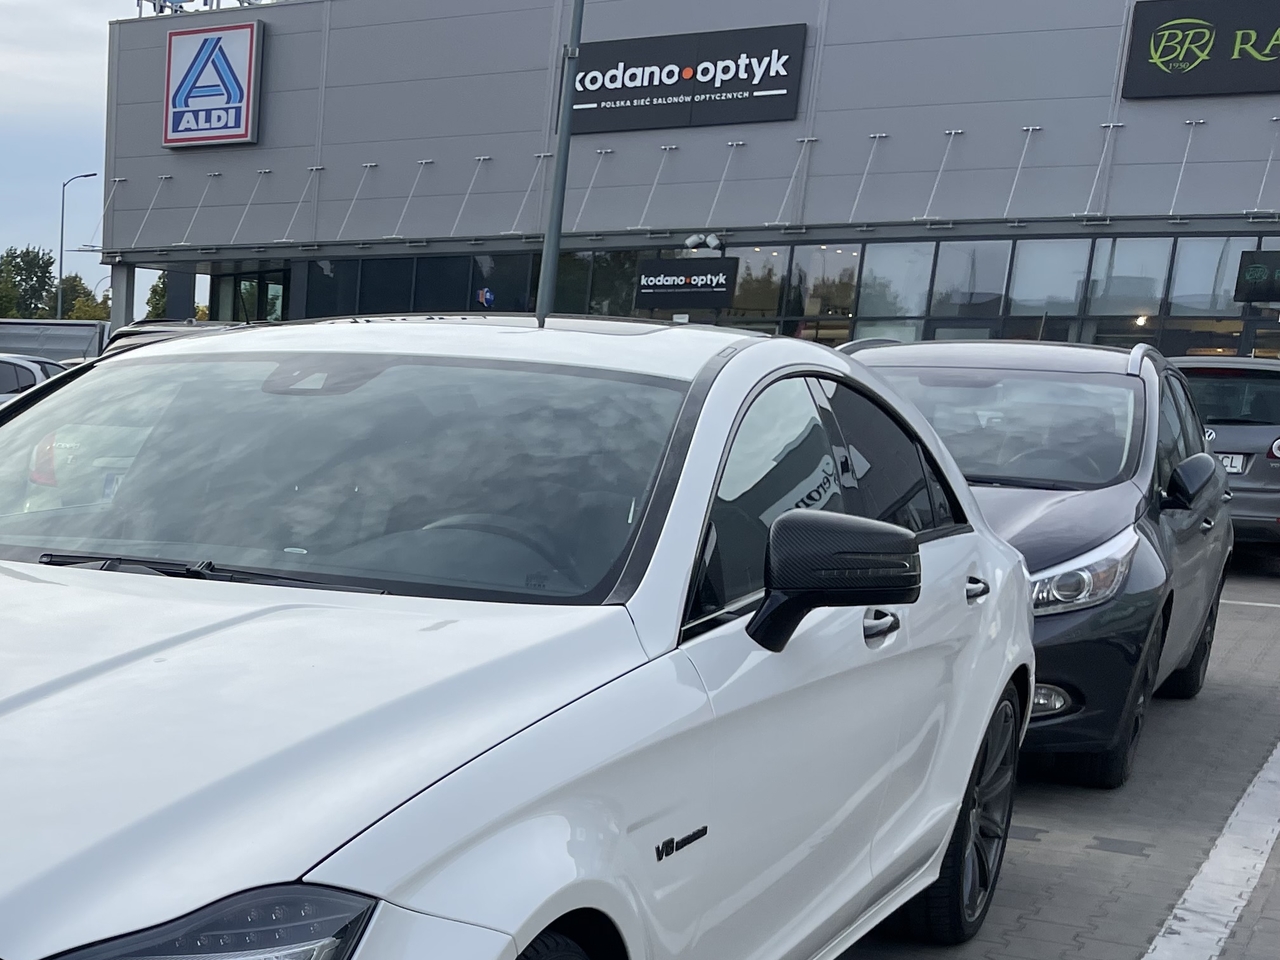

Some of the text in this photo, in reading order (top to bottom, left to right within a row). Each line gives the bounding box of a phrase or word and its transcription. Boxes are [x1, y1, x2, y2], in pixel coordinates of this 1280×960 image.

[696, 49, 789, 87] optyk
[600, 91, 749, 109] POLSKA SIEĆ SALONÓW OPTYCZNYCH
[177, 108, 236, 131] ALDI
[641, 273, 726, 287] kodano optyk
